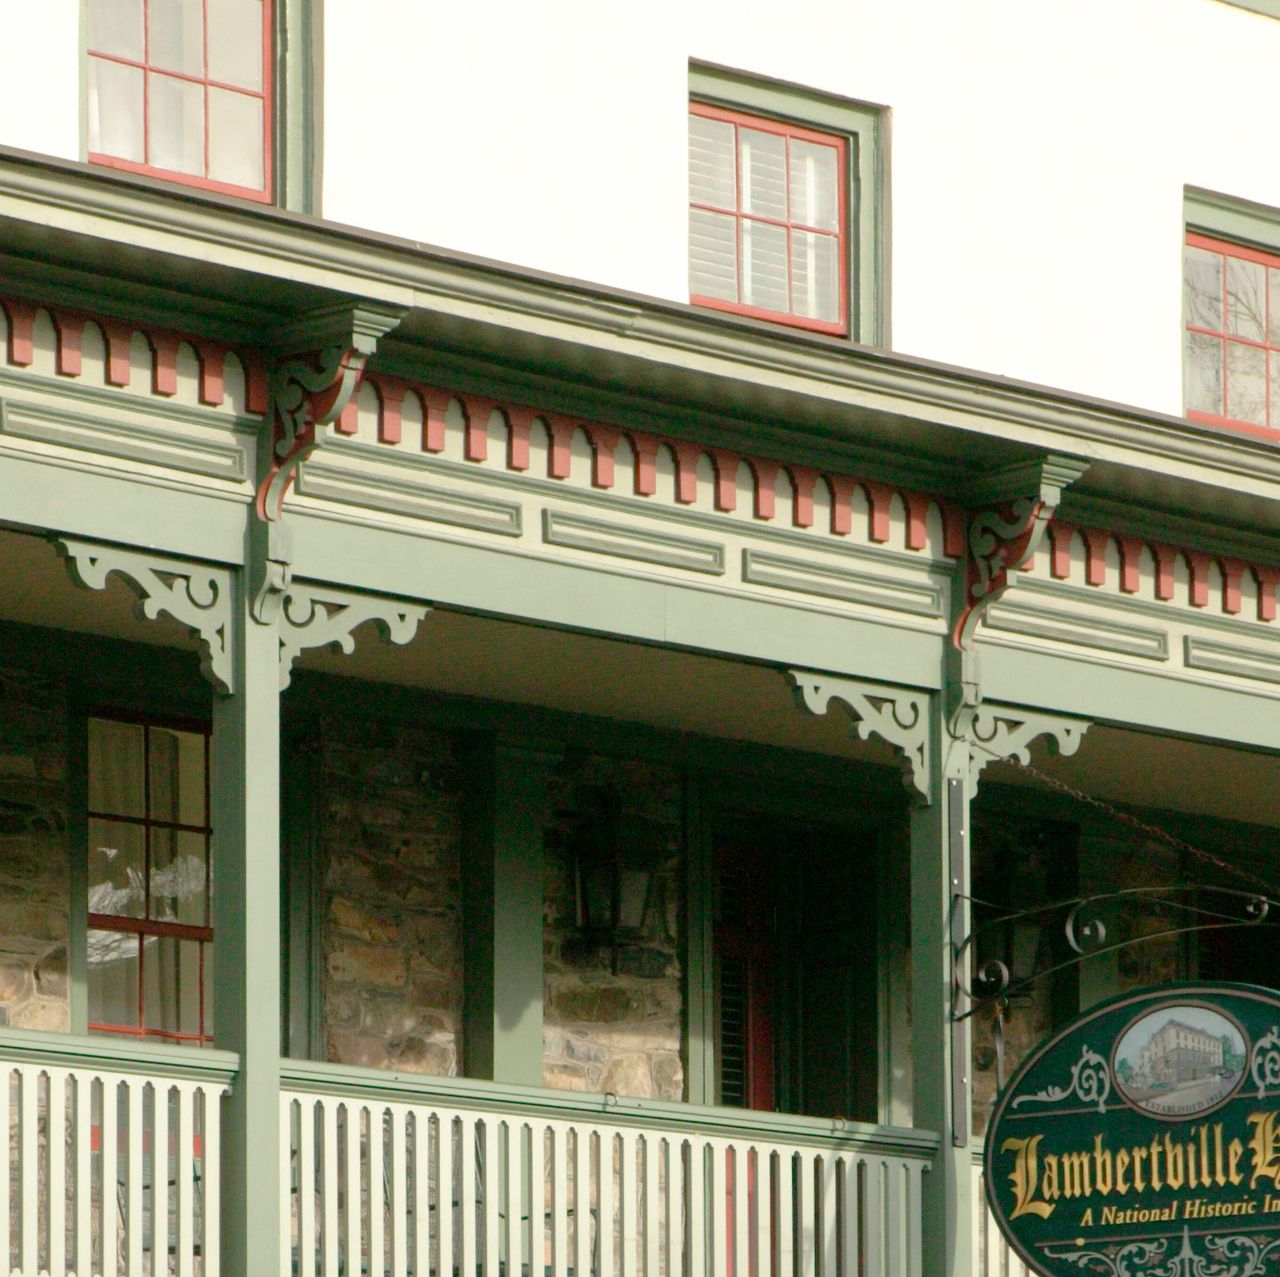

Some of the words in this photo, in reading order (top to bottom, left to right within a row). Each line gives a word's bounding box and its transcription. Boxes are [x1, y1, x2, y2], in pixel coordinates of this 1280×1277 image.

[1000, 1123, 1245, 1221] Lambertville
[1080, 1211, 1095, 1227] A
[1101, 1200, 1178, 1225] National
[1184, 1196, 1258, 1220] Historic
